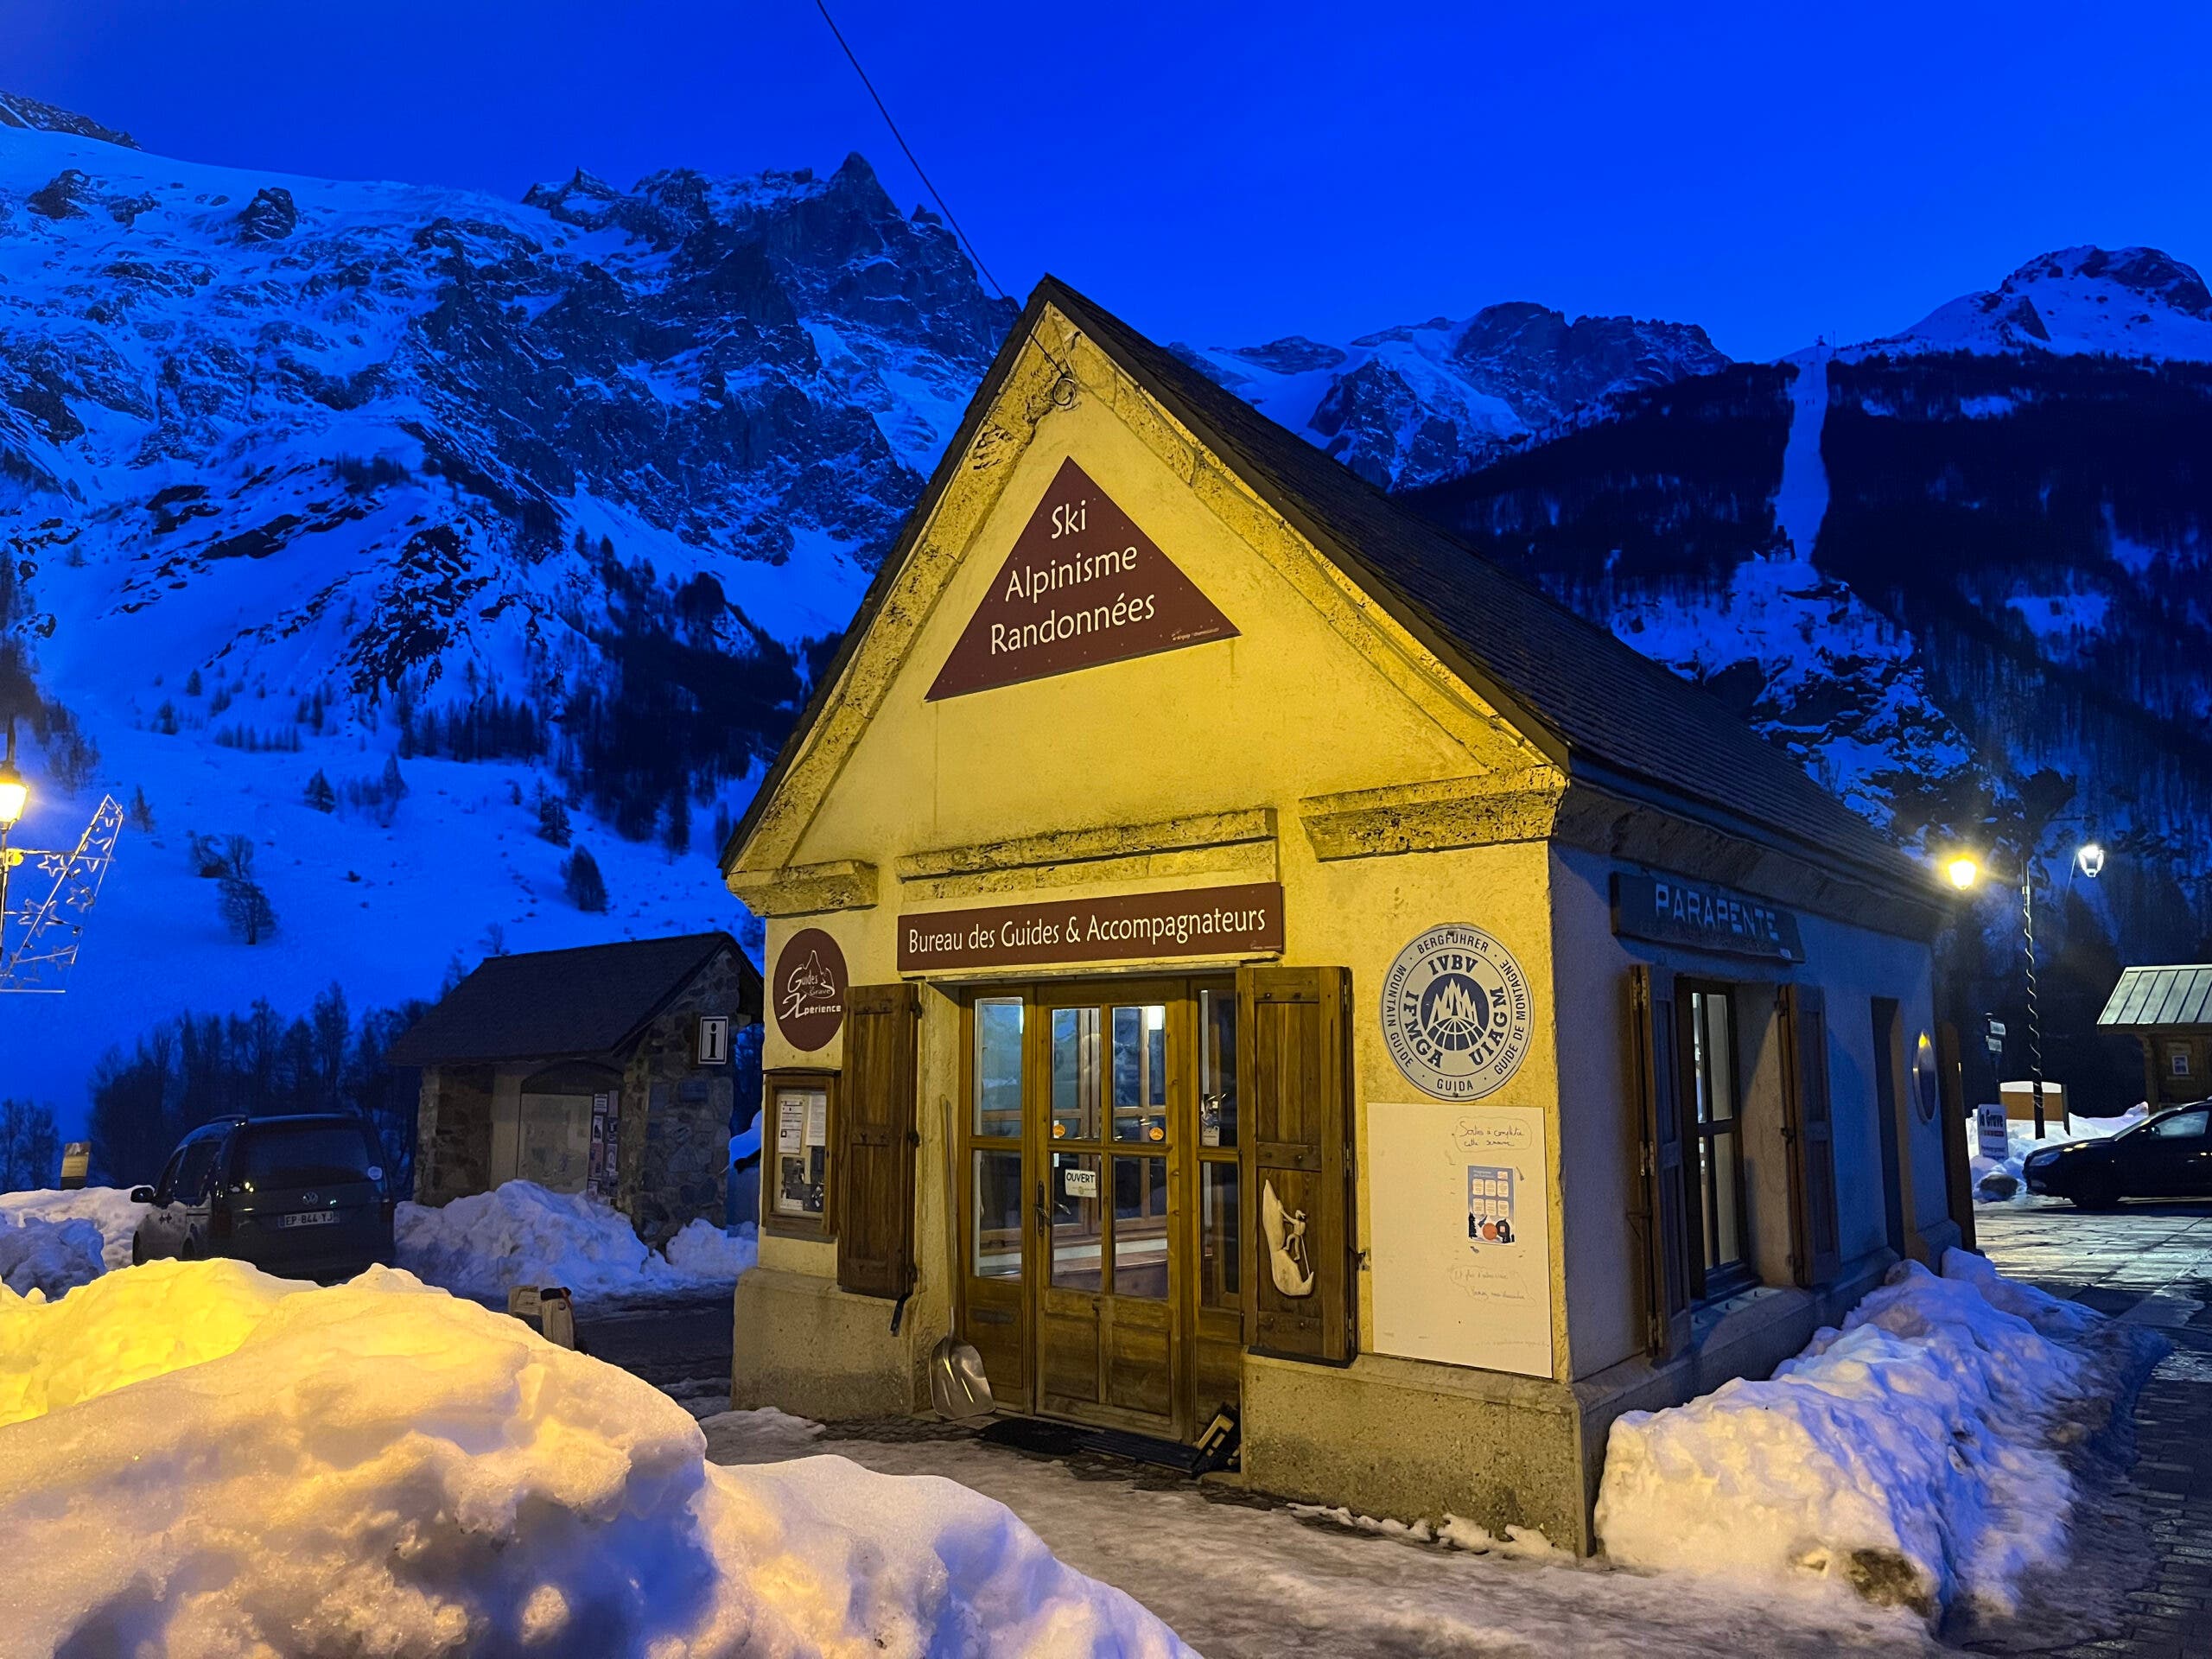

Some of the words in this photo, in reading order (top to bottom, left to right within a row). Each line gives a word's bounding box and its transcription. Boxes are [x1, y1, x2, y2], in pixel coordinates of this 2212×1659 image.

[1051, 499, 1087, 539] Ski
[1005, 546, 1138, 604] Alpinisme
[990, 592, 1155, 655] Randonnées
[908, 927, 963, 954] Bureau
[969, 924, 995, 950] des
[1001, 920, 1059, 947] Guides
[1065, 916, 1081, 943] &
[1086, 906, 1266, 944] Accompagnateurs
[1656, 883, 1779, 941] PARAPENTE
[1427, 954, 1478, 976] IVBV
[1386, 963, 1407, 1027] MOUNTAIN
[1499, 959, 1526, 1021] MONTAGNE
[1390, 1032, 1414, 1068] GUIDE
[1403, 990, 1444, 1069] IFMGA
[1468, 986, 1508, 1066] UIAGM
[1513, 1025, 1525, 1041] DE
[1493, 1044, 1519, 1076] GUIDE
[1436, 1078, 1474, 1092] GUIDA
[1066, 1172, 1095, 1183] OUVERT
